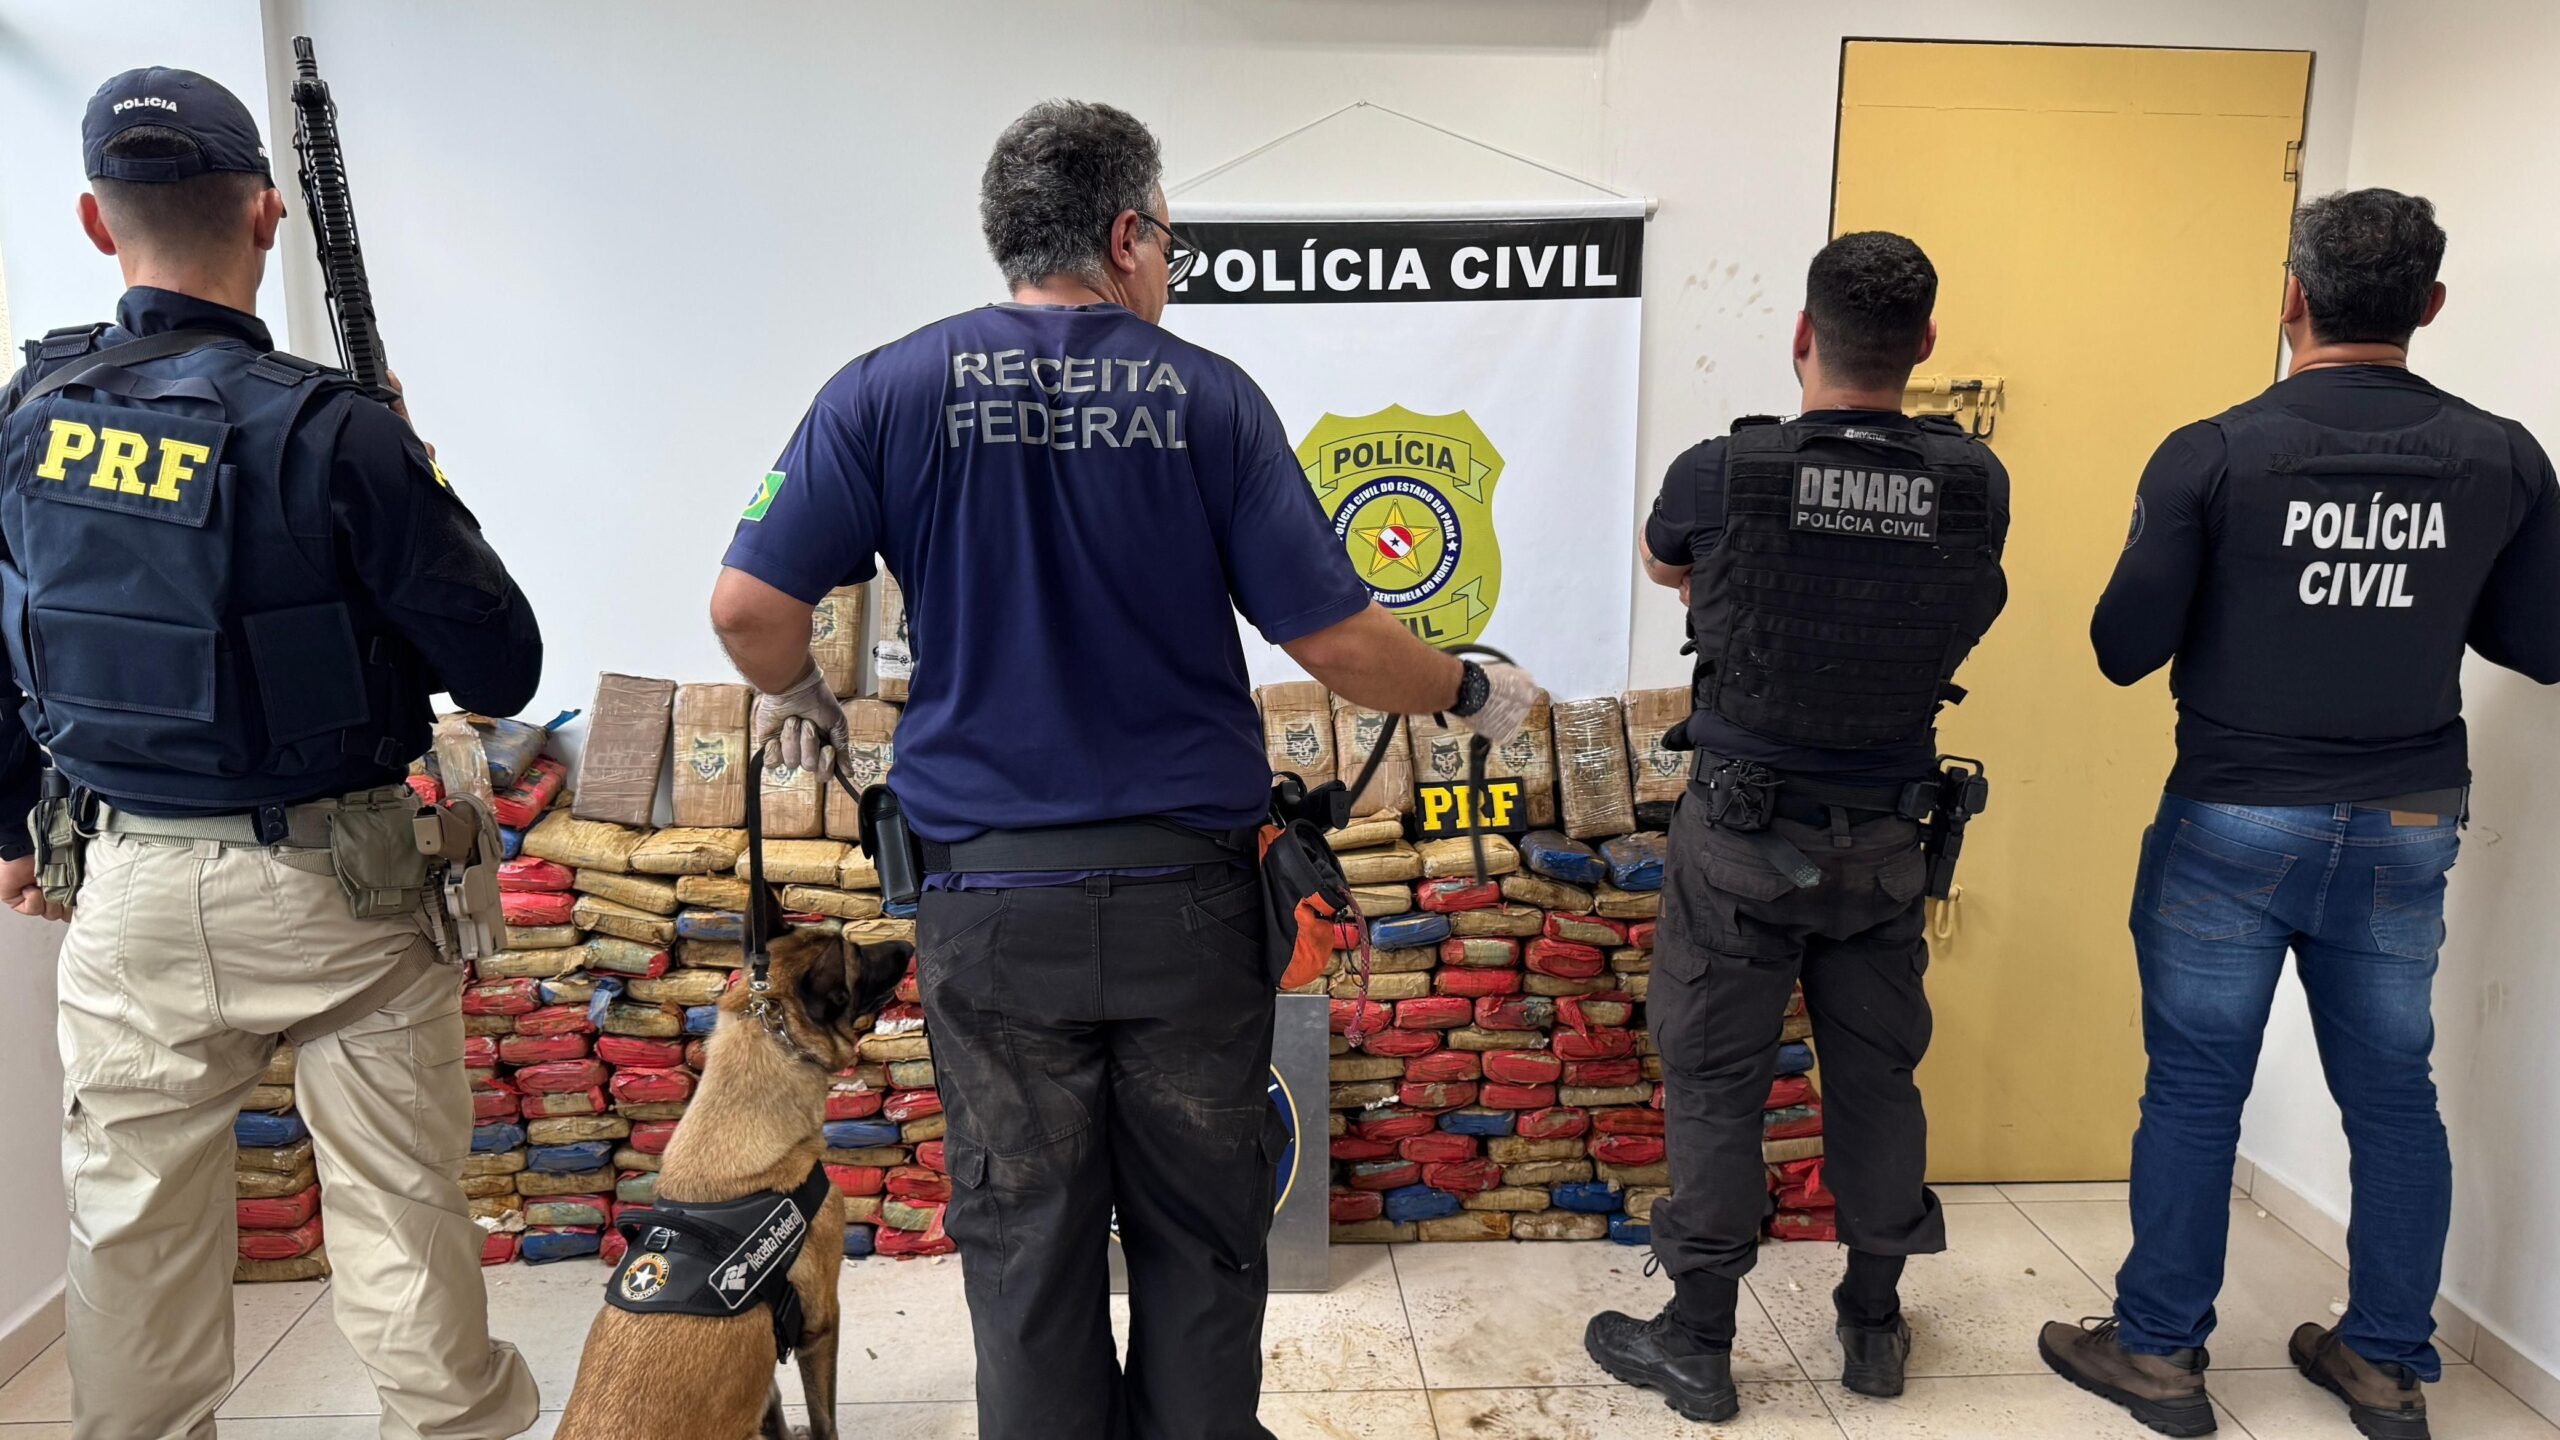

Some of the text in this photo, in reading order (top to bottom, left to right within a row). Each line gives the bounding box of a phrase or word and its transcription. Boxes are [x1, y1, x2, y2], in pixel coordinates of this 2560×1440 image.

[1173, 238, 1618, 292] POLÍCIA CIVIL
[951, 348, 1188, 395] RECEITA
[945, 400, 1187, 451] FEDERAL
[36, 419, 211, 502] PRF
[1333, 434, 1456, 474] POLÍCIA
[1335, 503, 1357, 541] OLÍCIA
[1353, 485, 1380, 506] CIVIL
[1380, 481, 1395, 493] DO
[1396, 481, 1435, 503] ESTADO
[1431, 498, 1446, 514] DO
[1798, 466, 1935, 516] DENARC
[1796, 507, 1930, 538] POLÍCIA CIVIL
[2282, 491, 2447, 550] POLÍCIA
[1372, 554, 1454, 604] SENTINELA DO NORTE
[2299, 561, 2414, 607] CIVIL
[1420, 782, 1519, 831] PRF
[744, 1204, 802, 1271] Receita Federal
